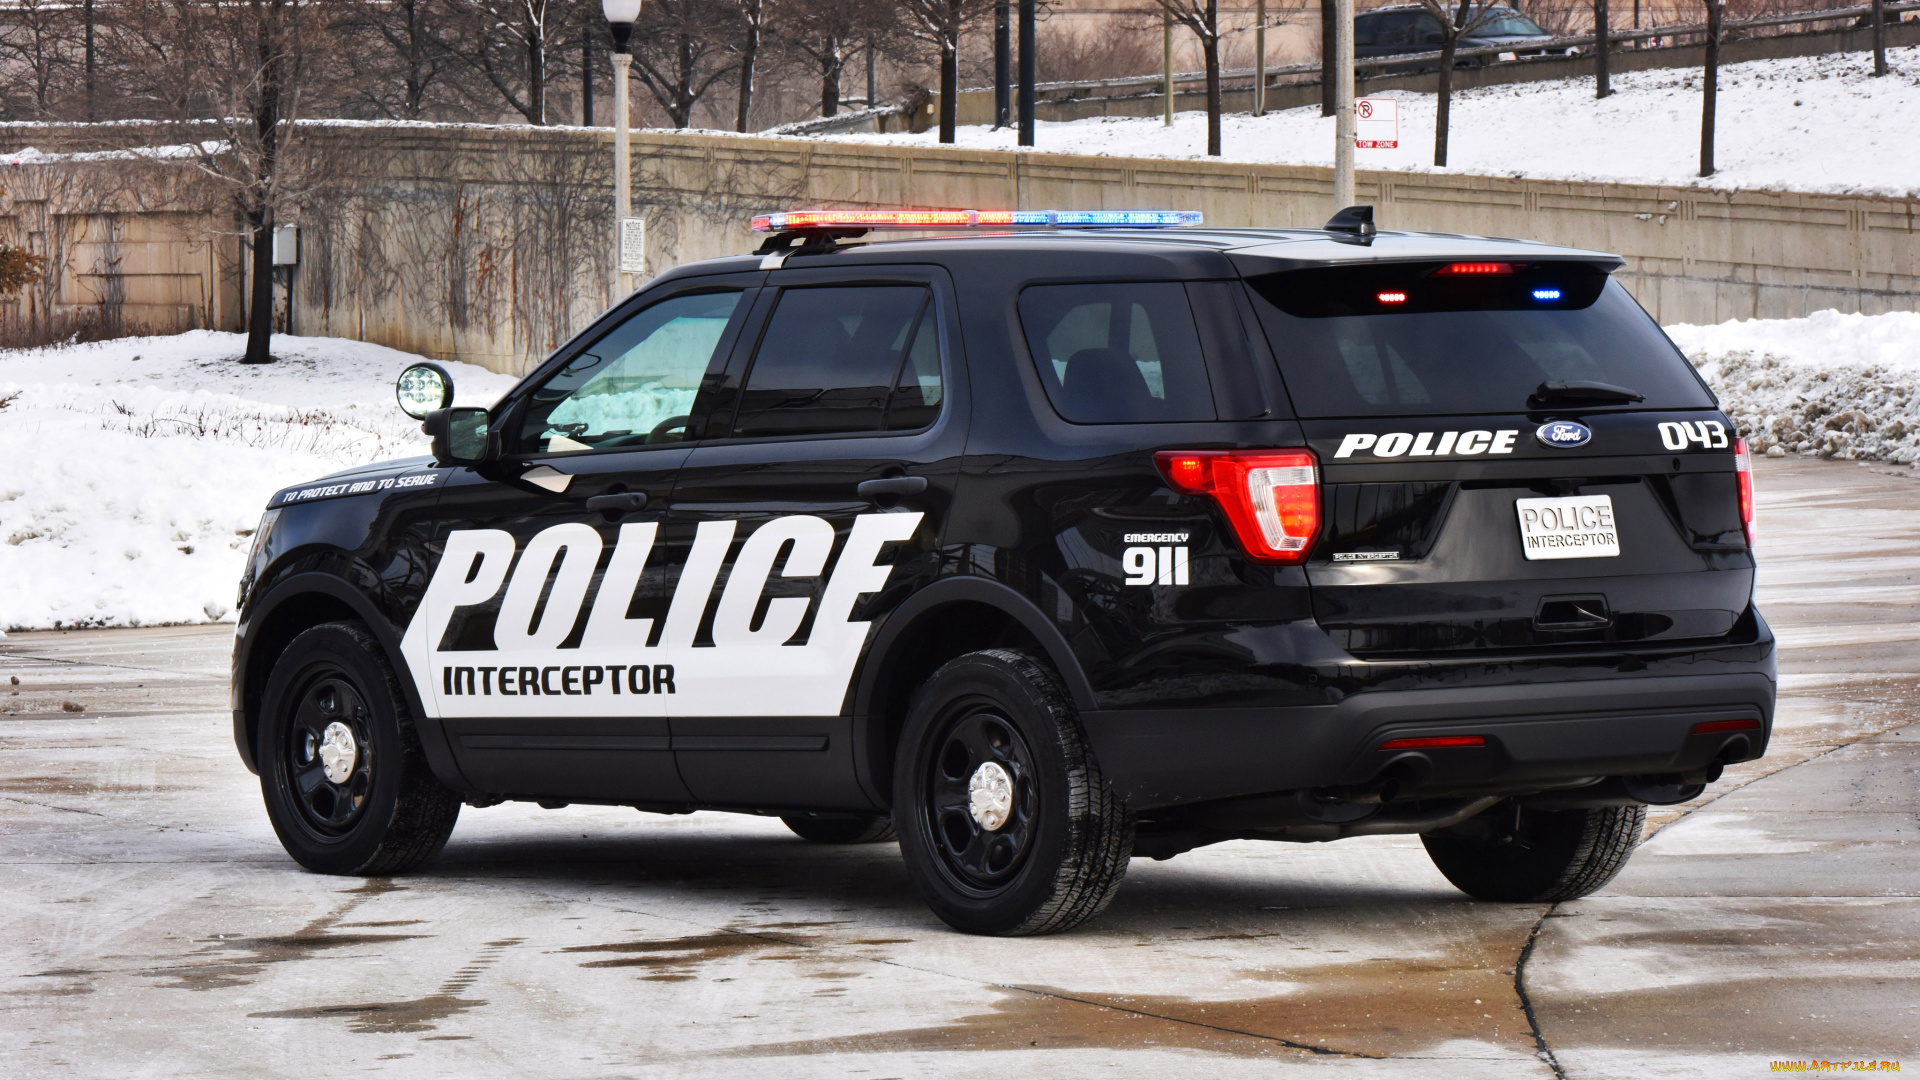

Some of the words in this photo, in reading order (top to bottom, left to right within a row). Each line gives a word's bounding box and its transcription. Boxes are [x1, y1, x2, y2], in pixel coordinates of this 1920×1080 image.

[1358, 140, 1373, 148] TOW
[1376, 140, 1395, 148] ZONE
[1333, 429, 1519, 459] POLICE
[1551, 424, 1582, 442] Ford
[1657, 420, 1729, 451] 043
[283, 491, 298, 503] TO
[297, 483, 350, 500] PROTECT
[348, 480, 377, 493] AND
[378, 478, 395, 490] TO
[394, 473, 439, 488] SERVE
[1521, 505, 1614, 533] POLICE
[1123, 533, 1189, 543] EMERGENCY
[1526, 532, 1616, 549] INTERCEPTOR
[1122, 546, 1190, 586] 911
[432, 511, 925, 653] POLICE
[442, 663, 677, 697] INTERCEPTOR
